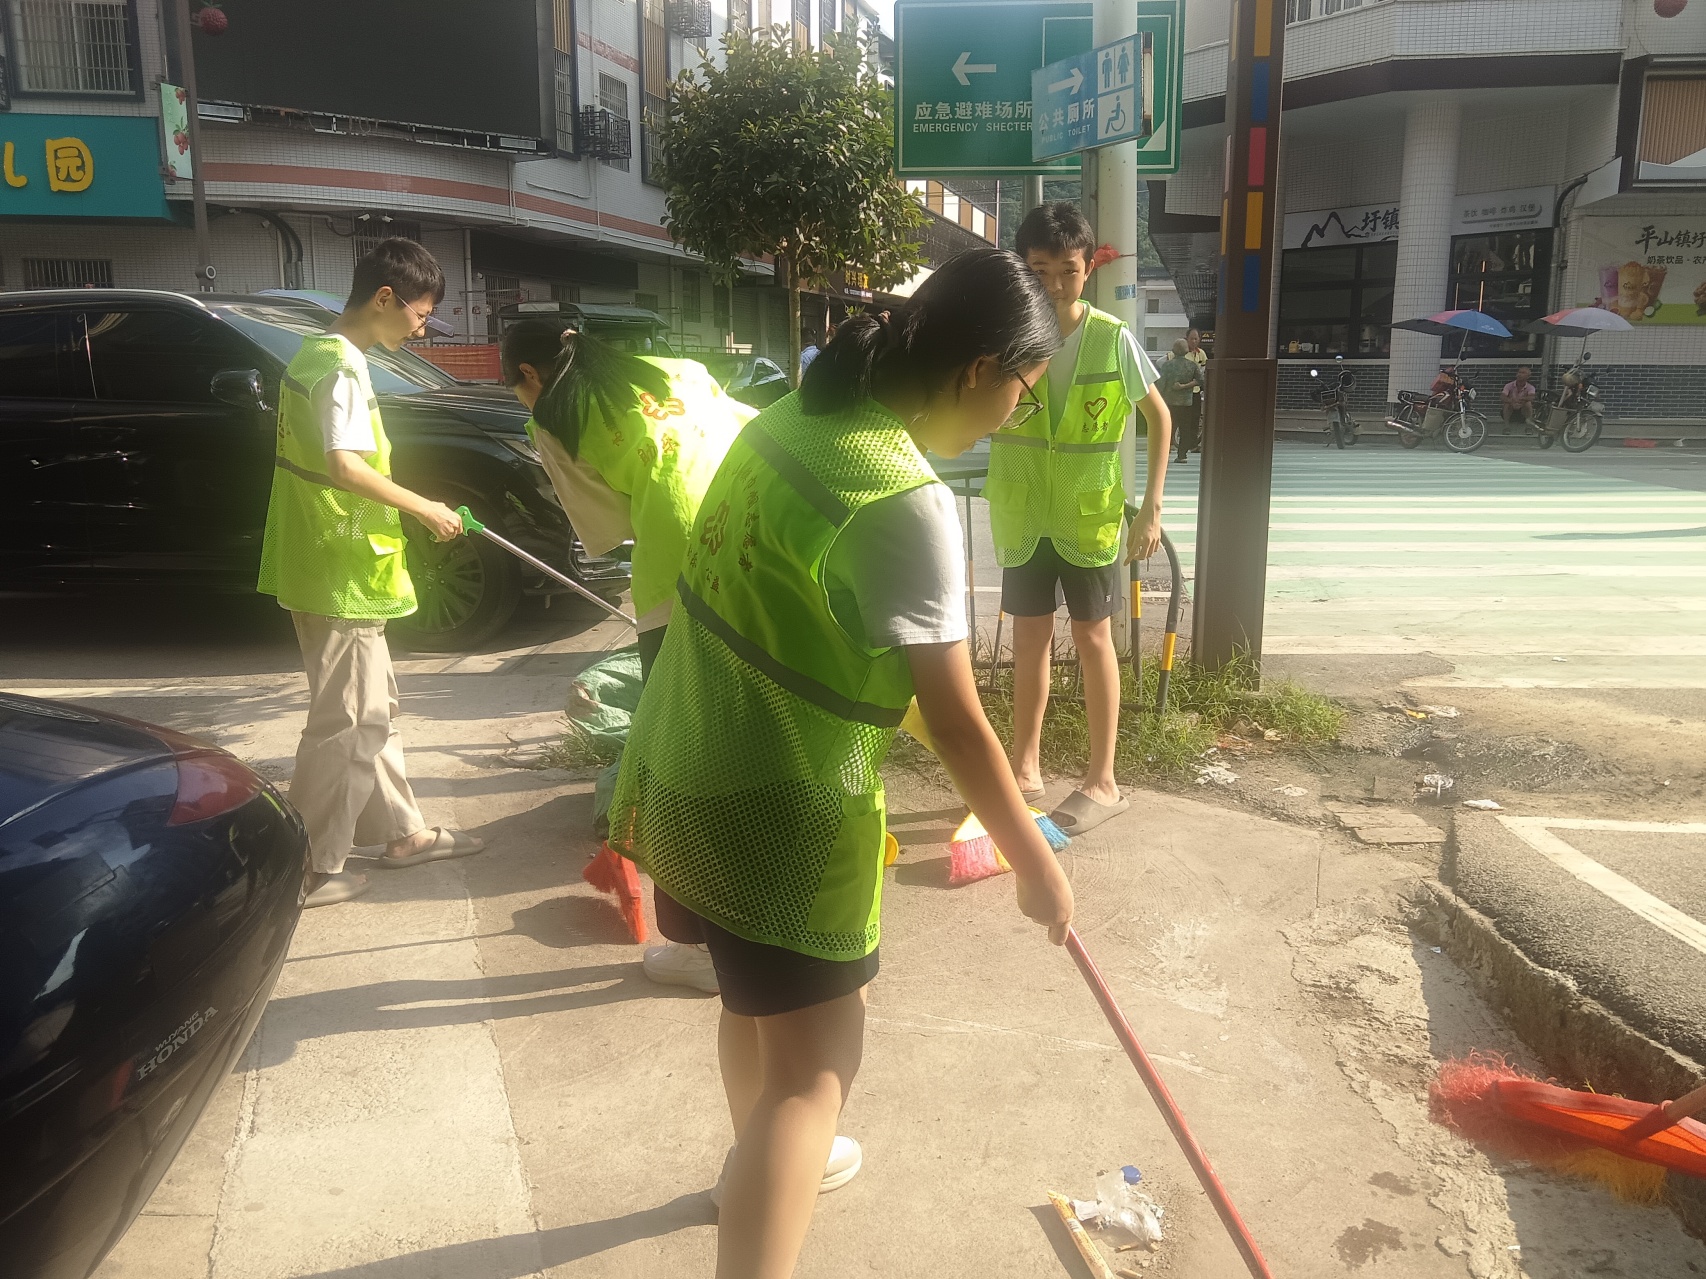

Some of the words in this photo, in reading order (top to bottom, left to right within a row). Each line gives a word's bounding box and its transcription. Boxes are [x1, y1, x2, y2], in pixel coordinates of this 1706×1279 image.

[914, 101, 1032, 120] 应急避难场所
[1039, 98, 1095, 131] 公共厕所
[913, 122, 978, 133] EMERGENCY
[986, 121, 1032, 132] SHECTER
[1041, 132, 1063, 143] PUBLIC
[1068, 124, 1091, 136] TOILET
[1361, 207, 1399, 232] 圩镇
[1635, 224, 1706, 255] 平山镇圩
[137, 1006, 219, 1081] HONDA
[155, 1010, 200, 1052] WUYANG
